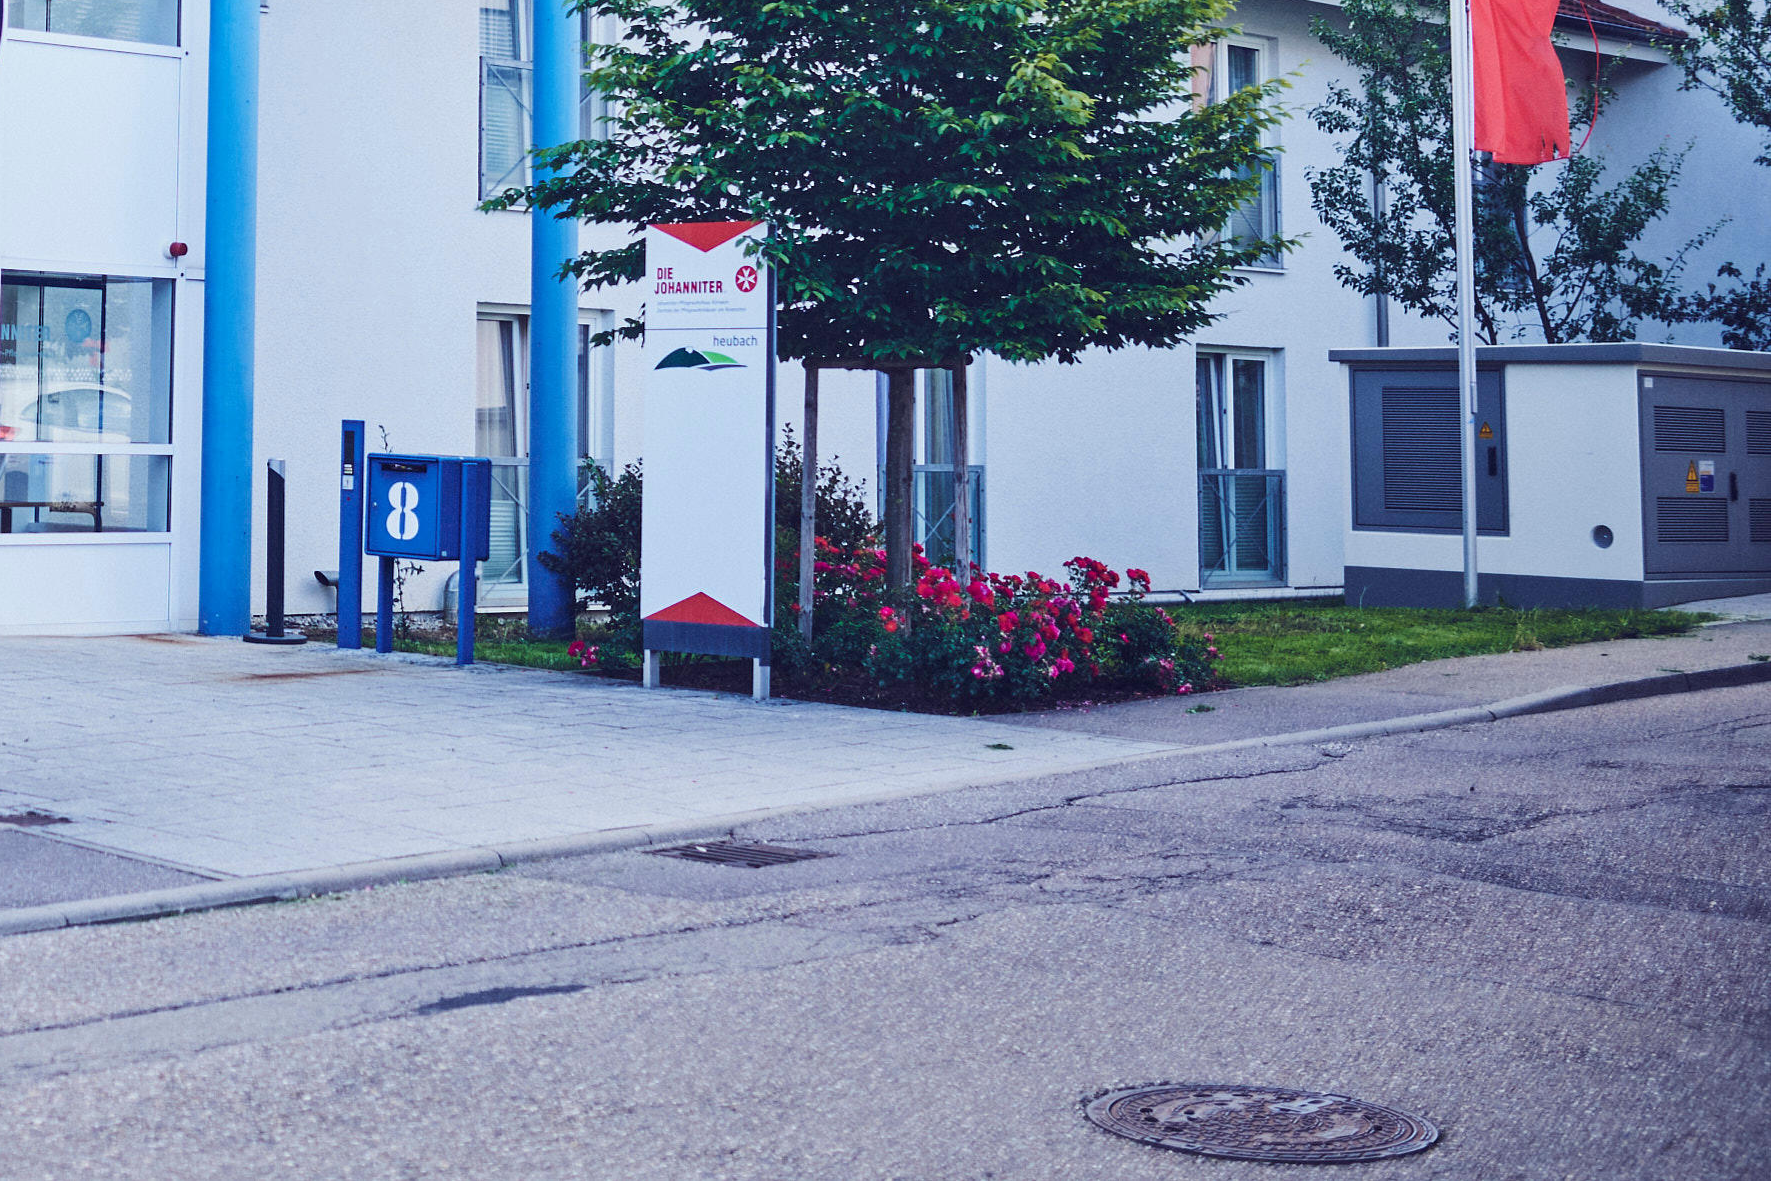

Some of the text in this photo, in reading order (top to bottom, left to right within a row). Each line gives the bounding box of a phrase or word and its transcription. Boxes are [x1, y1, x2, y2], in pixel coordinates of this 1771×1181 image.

[656, 267, 674, 280] DIE
[654, 280, 723, 295] JOHANNITER
[712, 334, 758, 347] heubach
[386, 481, 419, 541] 8
